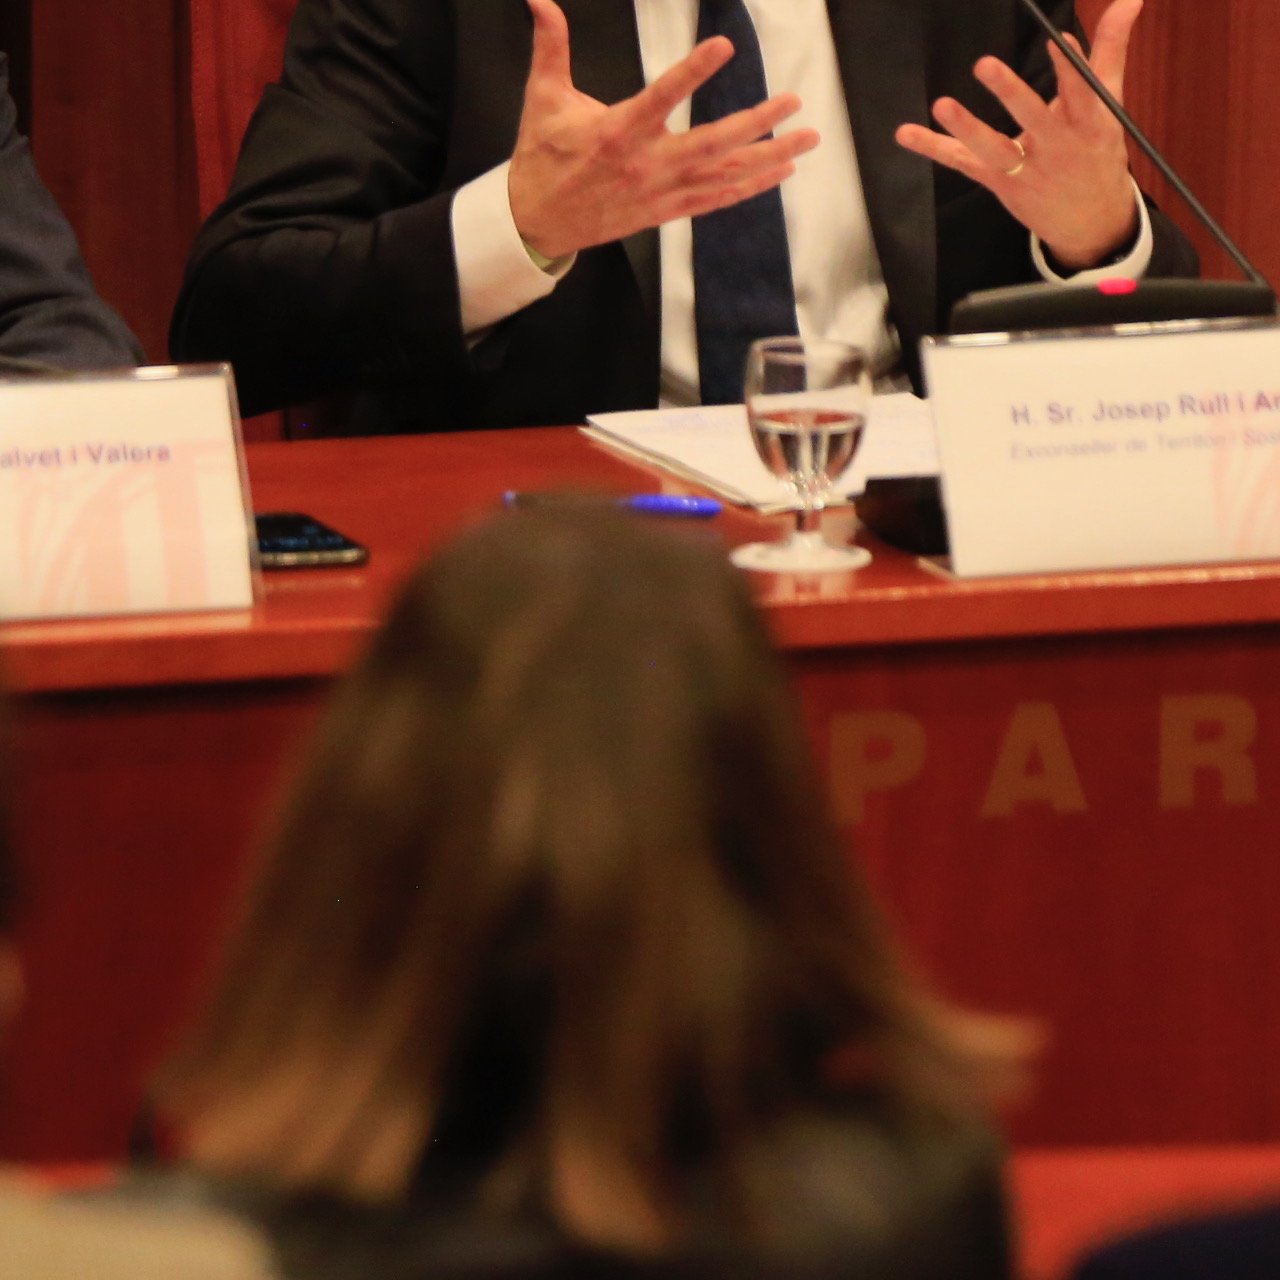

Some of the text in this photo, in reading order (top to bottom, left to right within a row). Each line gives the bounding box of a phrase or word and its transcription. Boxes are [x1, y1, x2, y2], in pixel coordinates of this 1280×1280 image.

[1010, 404, 1037, 426] H.
[1047, 401, 1083, 424] Sr.
[1092, 399, 1171, 423] Josep
[1178, 392, 1229, 416] Rull
[86, 441, 171, 465] Valera
